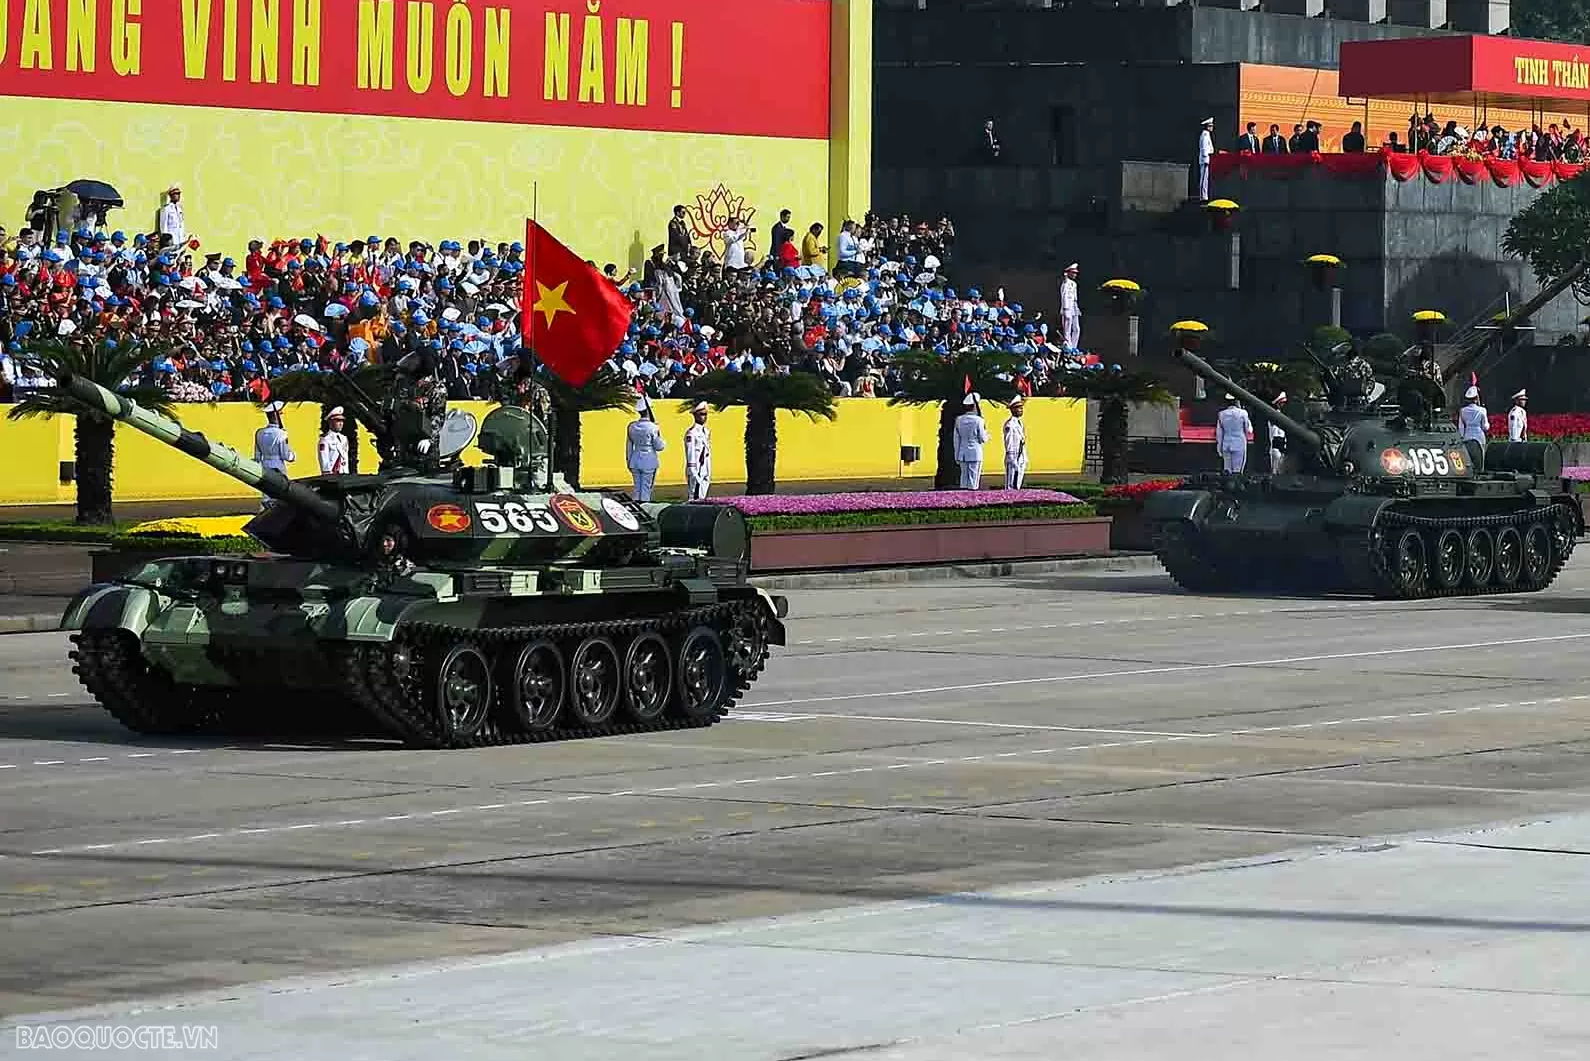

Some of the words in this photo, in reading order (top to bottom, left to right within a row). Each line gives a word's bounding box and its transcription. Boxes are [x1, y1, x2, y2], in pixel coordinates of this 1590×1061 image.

[1514, 56, 1549, 85] TINH
[1552, 54, 1590, 89] THẦN
[1408, 448, 1449, 475] 135
